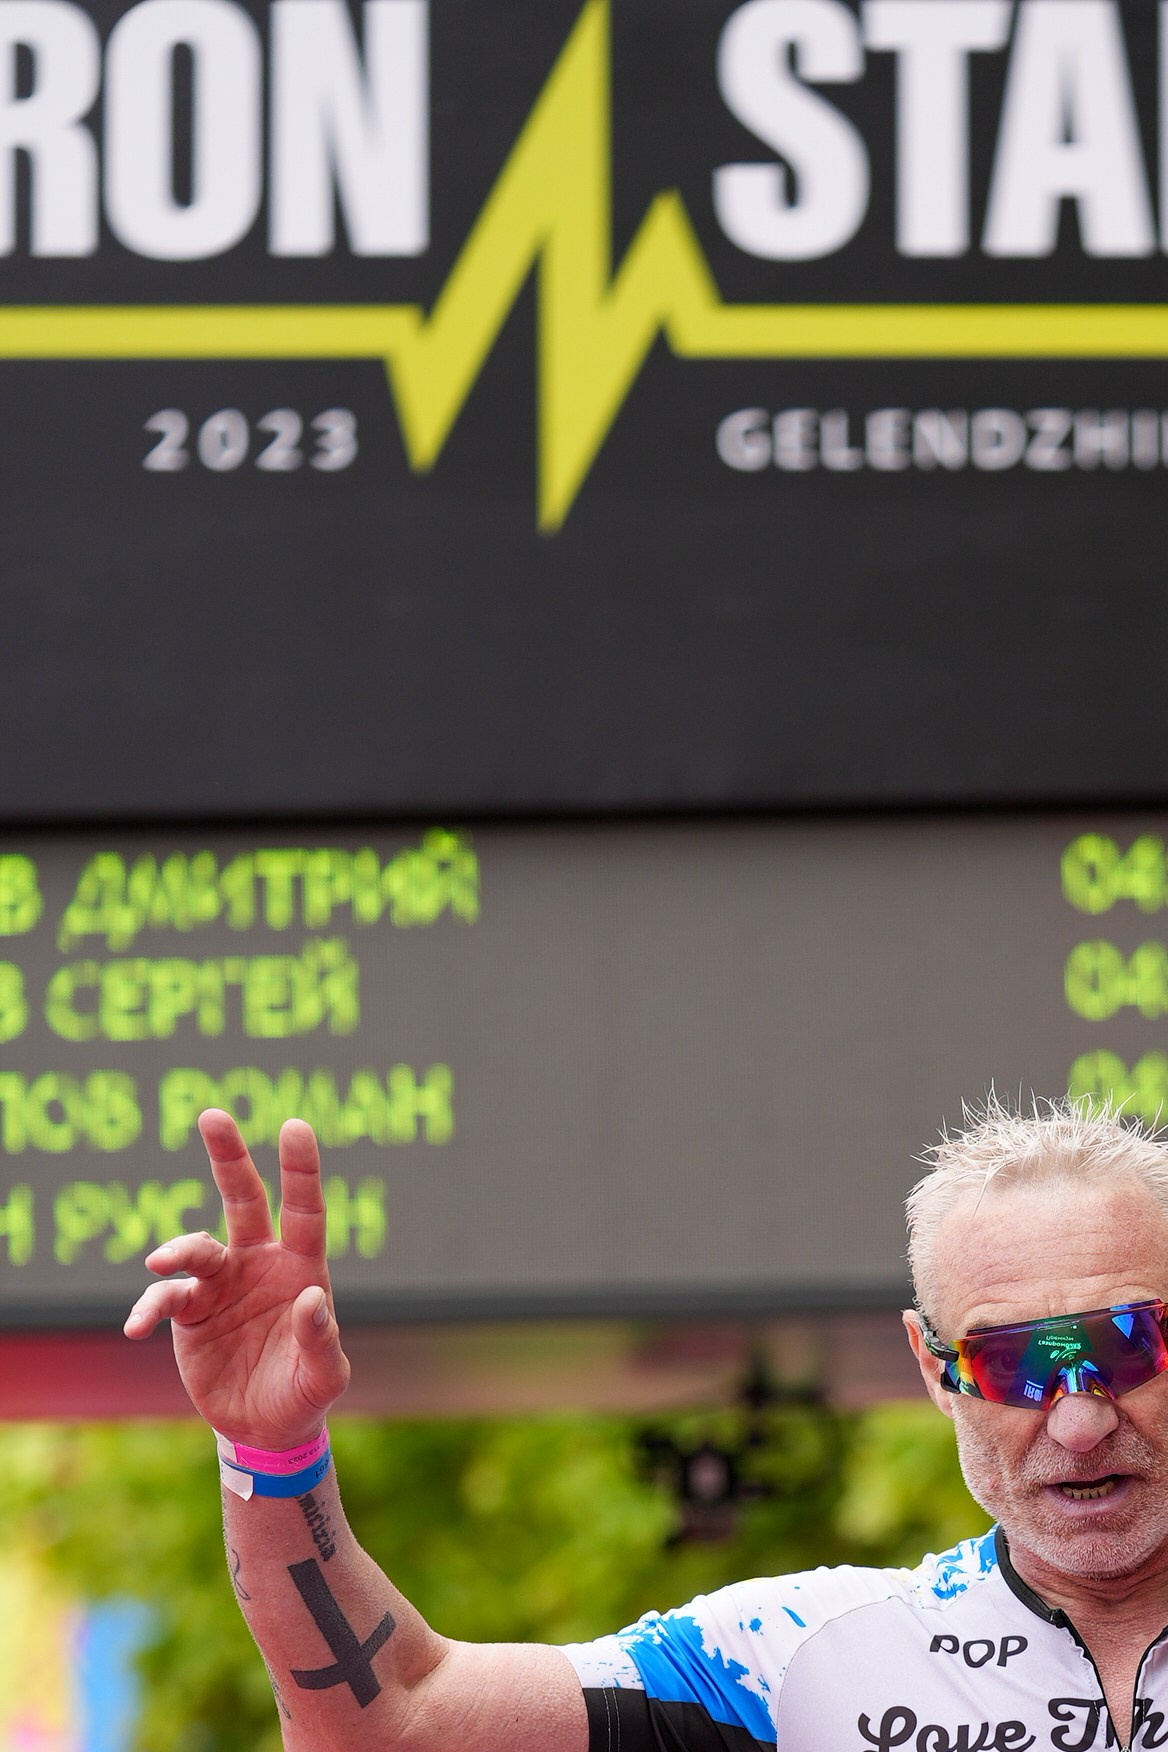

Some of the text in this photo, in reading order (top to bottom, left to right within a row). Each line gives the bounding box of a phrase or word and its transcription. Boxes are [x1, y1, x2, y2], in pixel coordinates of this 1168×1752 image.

[142, 410, 359, 473] 2023
[57, 828, 480, 953] ДМИТРИЙ
[46, 937, 360, 1041] СЕРГЕЙ
[929, 1634, 1028, 1669] POP
